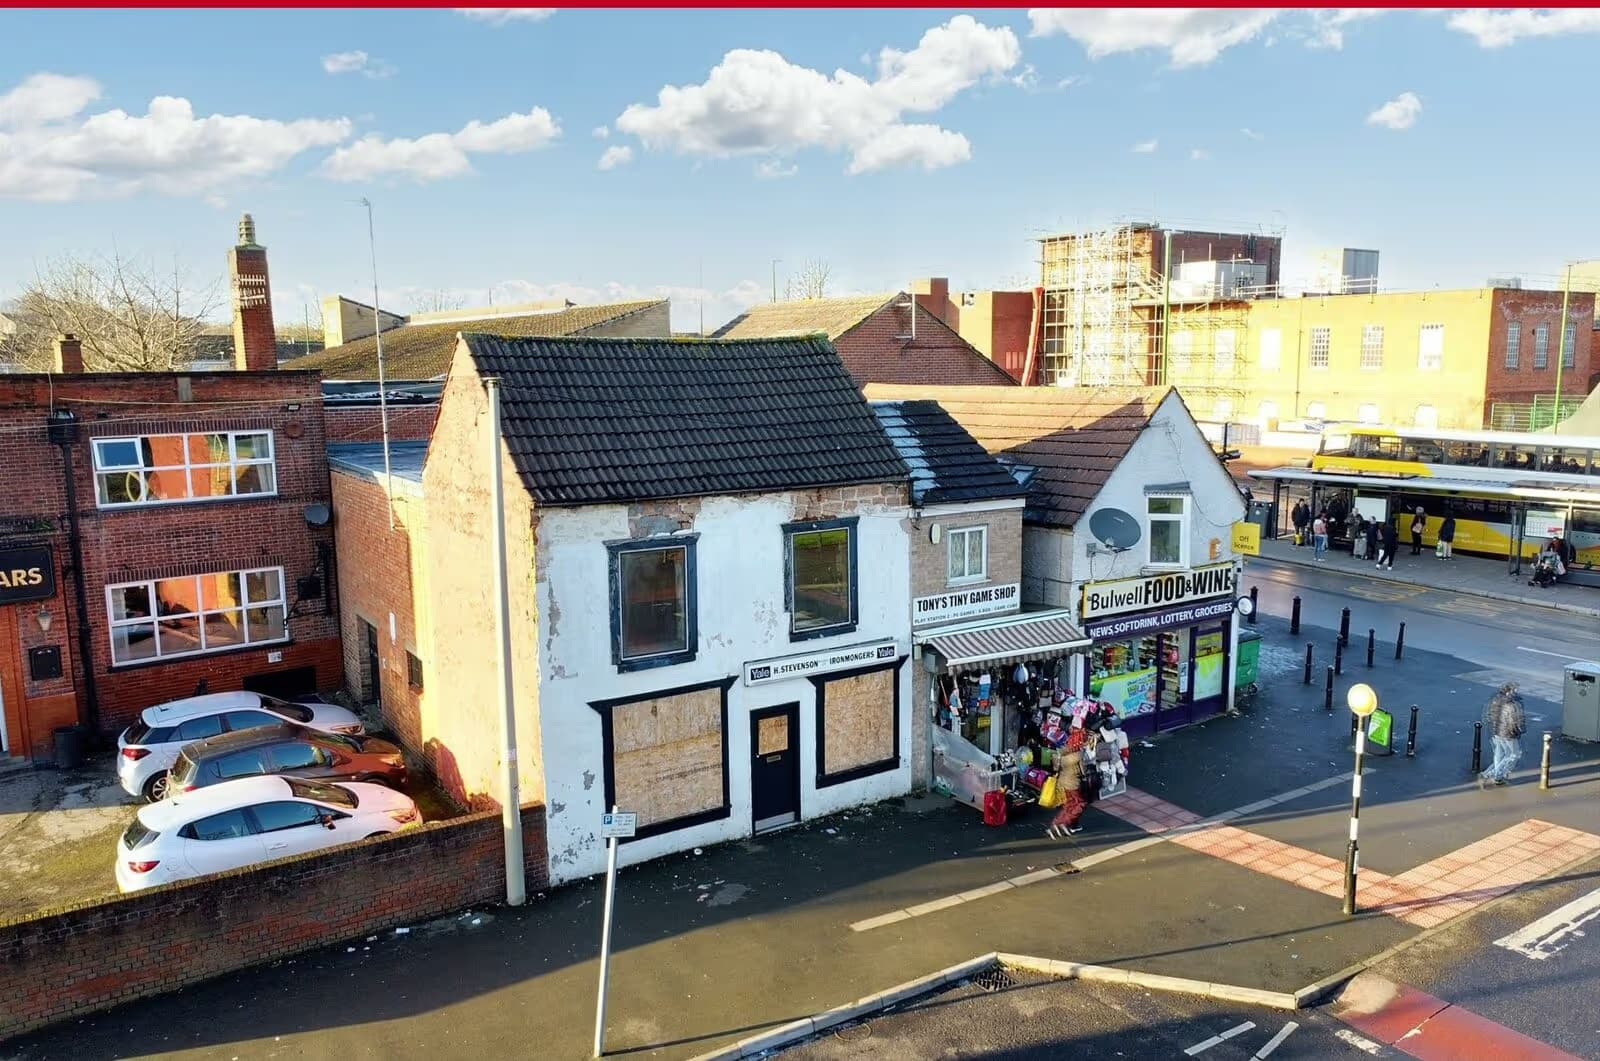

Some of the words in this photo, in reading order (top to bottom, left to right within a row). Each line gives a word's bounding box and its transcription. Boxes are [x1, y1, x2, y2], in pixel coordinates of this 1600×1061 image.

[917, 596, 947, 613] TONY'S
[949, 593, 969, 607] TINY
[970, 589, 993, 604] GAME
[994, 586, 1016, 600] SHOP
[1091, 585, 1142, 611] Bulwell
[1161, 610, 1194, 625] LOTTERY,
[1195, 602, 1233, 618] GROCERIES
[829, 651, 875, 665] IRONMONGERS
